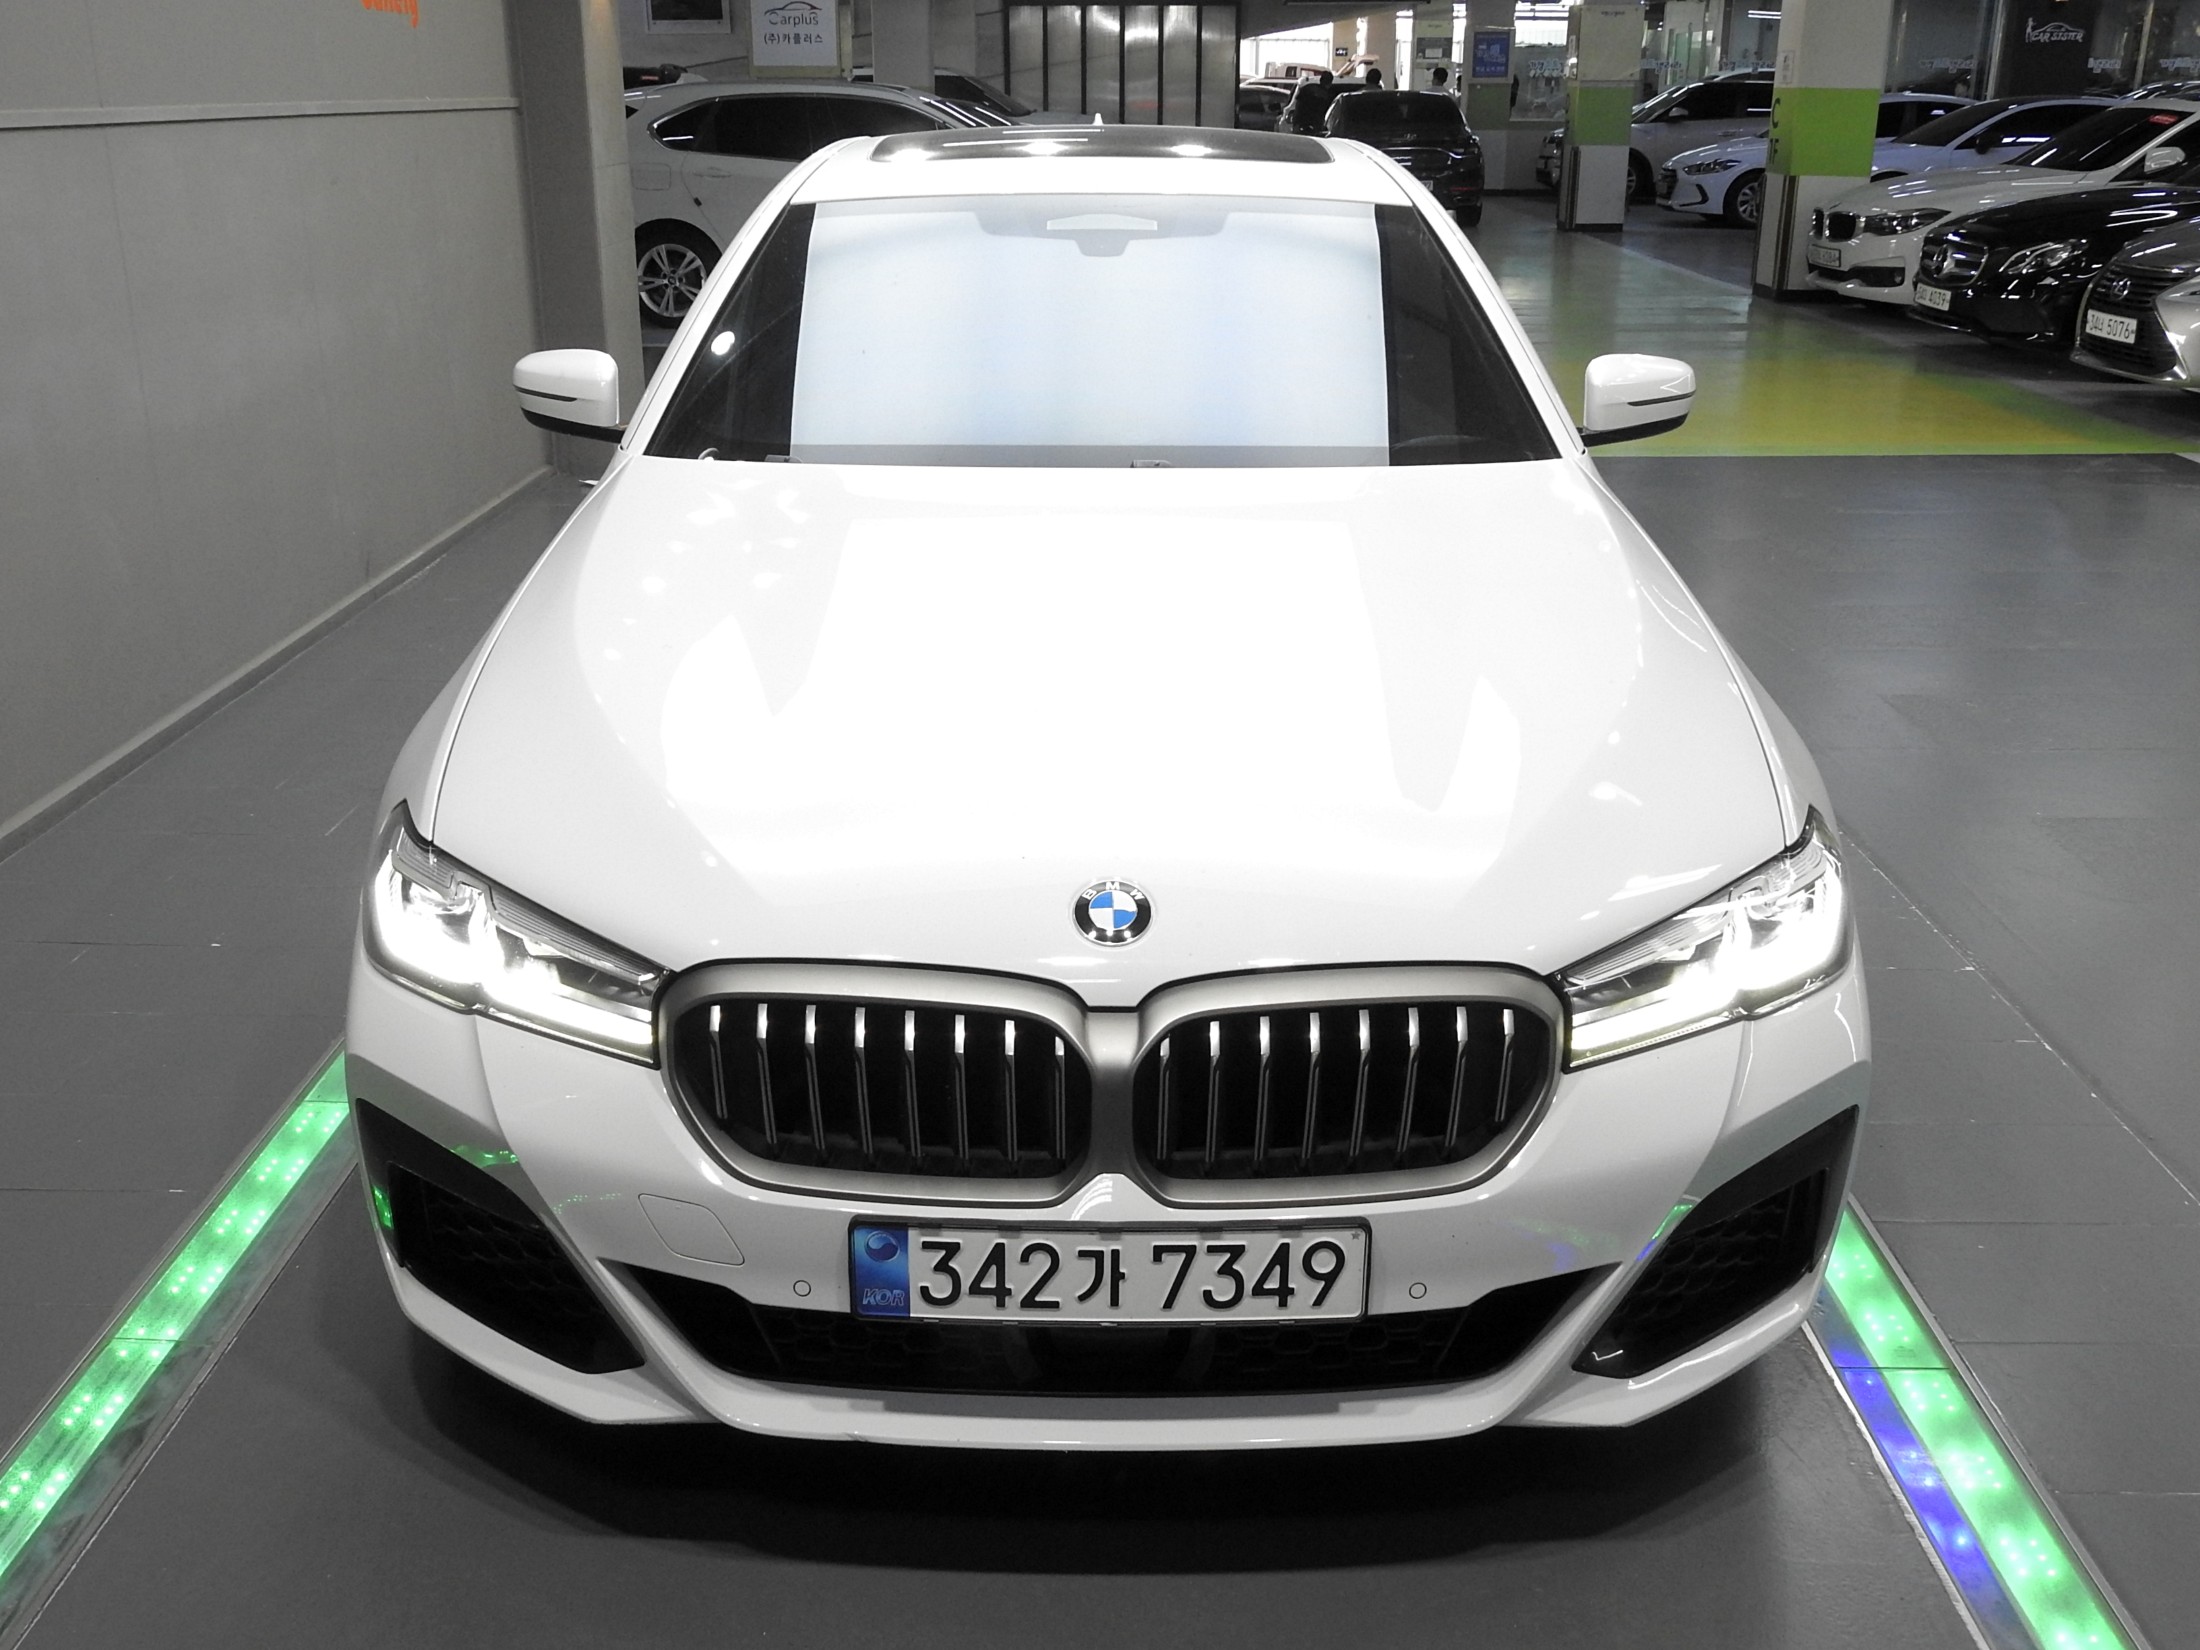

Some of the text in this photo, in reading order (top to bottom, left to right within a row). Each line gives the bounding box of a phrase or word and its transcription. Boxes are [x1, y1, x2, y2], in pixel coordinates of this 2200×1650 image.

[768, 12, 819, 27] Carplus
[763, 33, 823, 44] (주)카플러스
[2032, 32, 2050, 42] CAR
[2106, 319, 2130, 339] 5076
[1081, 881, 1145, 900] BMW
[919, 1239, 1346, 1310] 342가 7349
[862, 1288, 905, 1307] KOR
